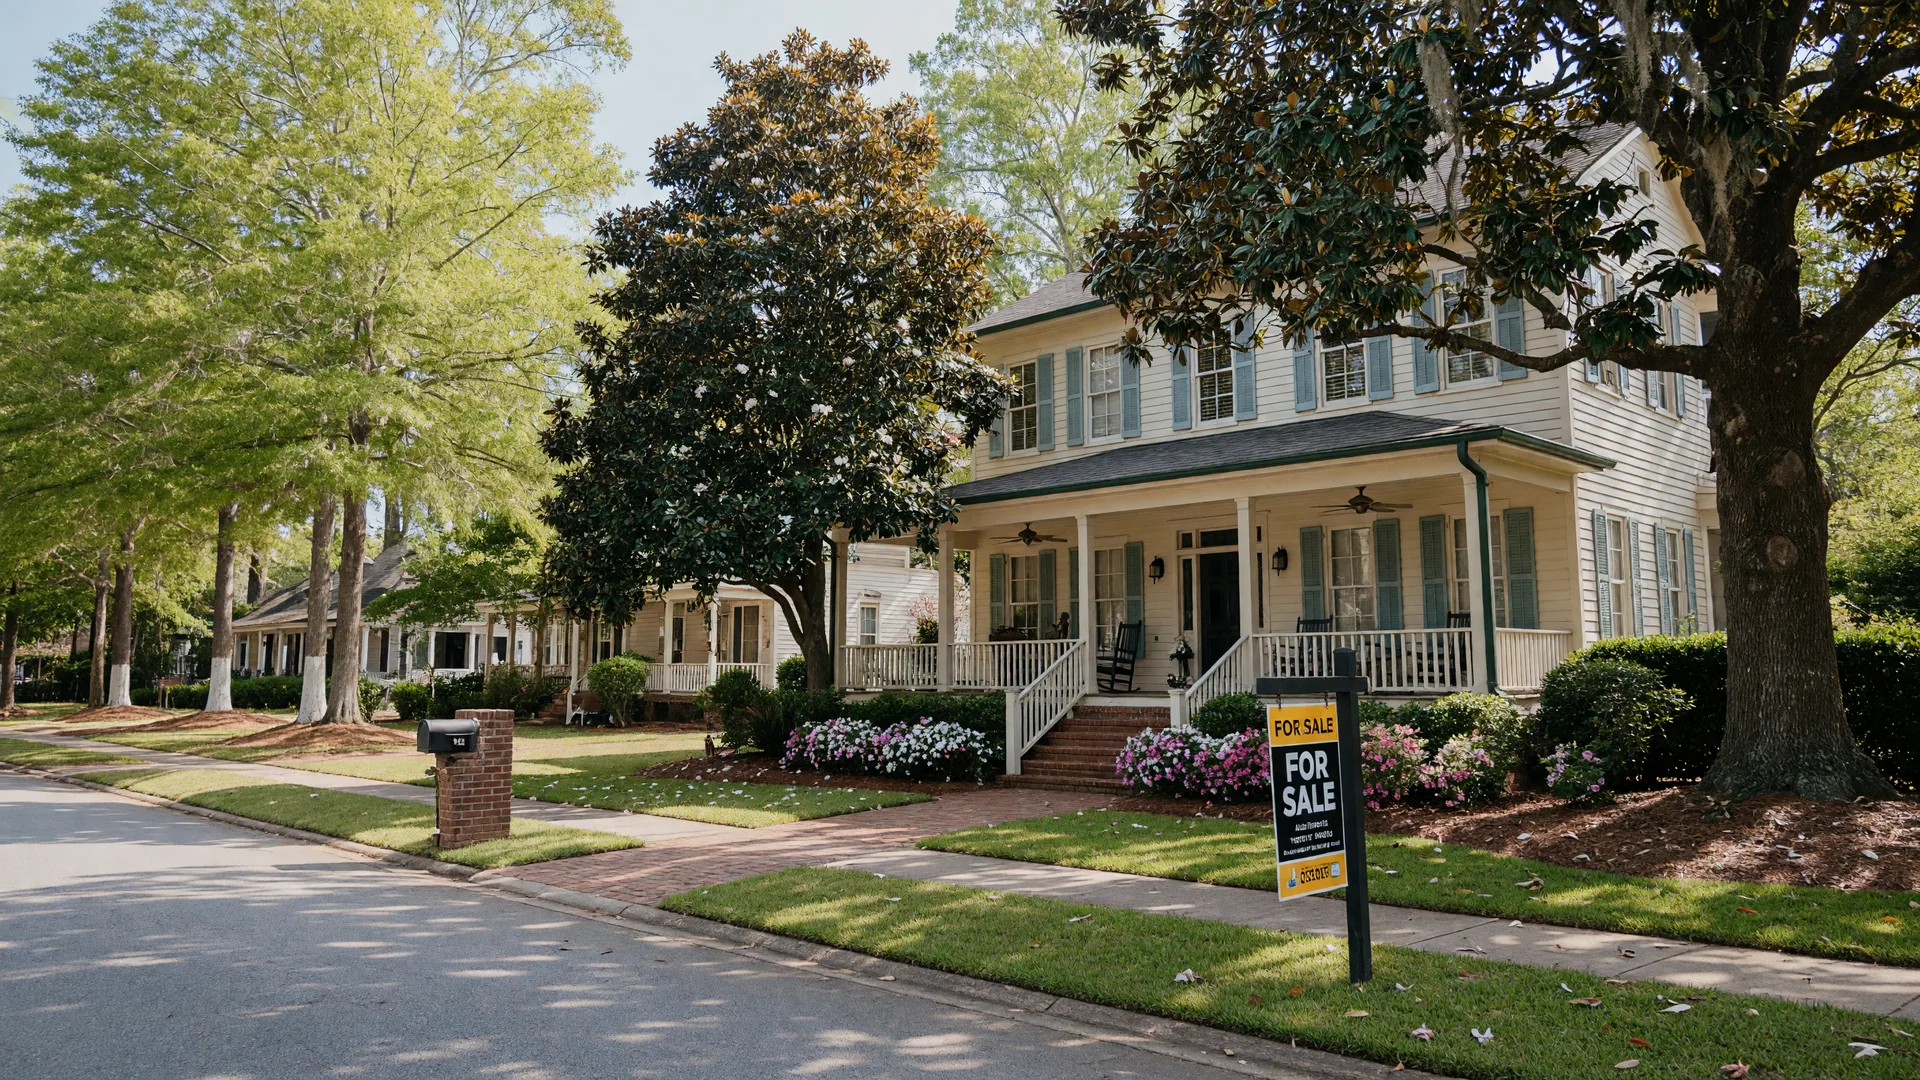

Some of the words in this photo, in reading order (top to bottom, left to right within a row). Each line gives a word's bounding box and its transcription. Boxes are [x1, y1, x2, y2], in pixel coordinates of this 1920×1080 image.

[1275, 719, 1301, 737] FOR
[1303, 717, 1333, 735] SALE
[1285, 750, 1329, 782] FOR
[1282, 781, 1336, 817] SALE
